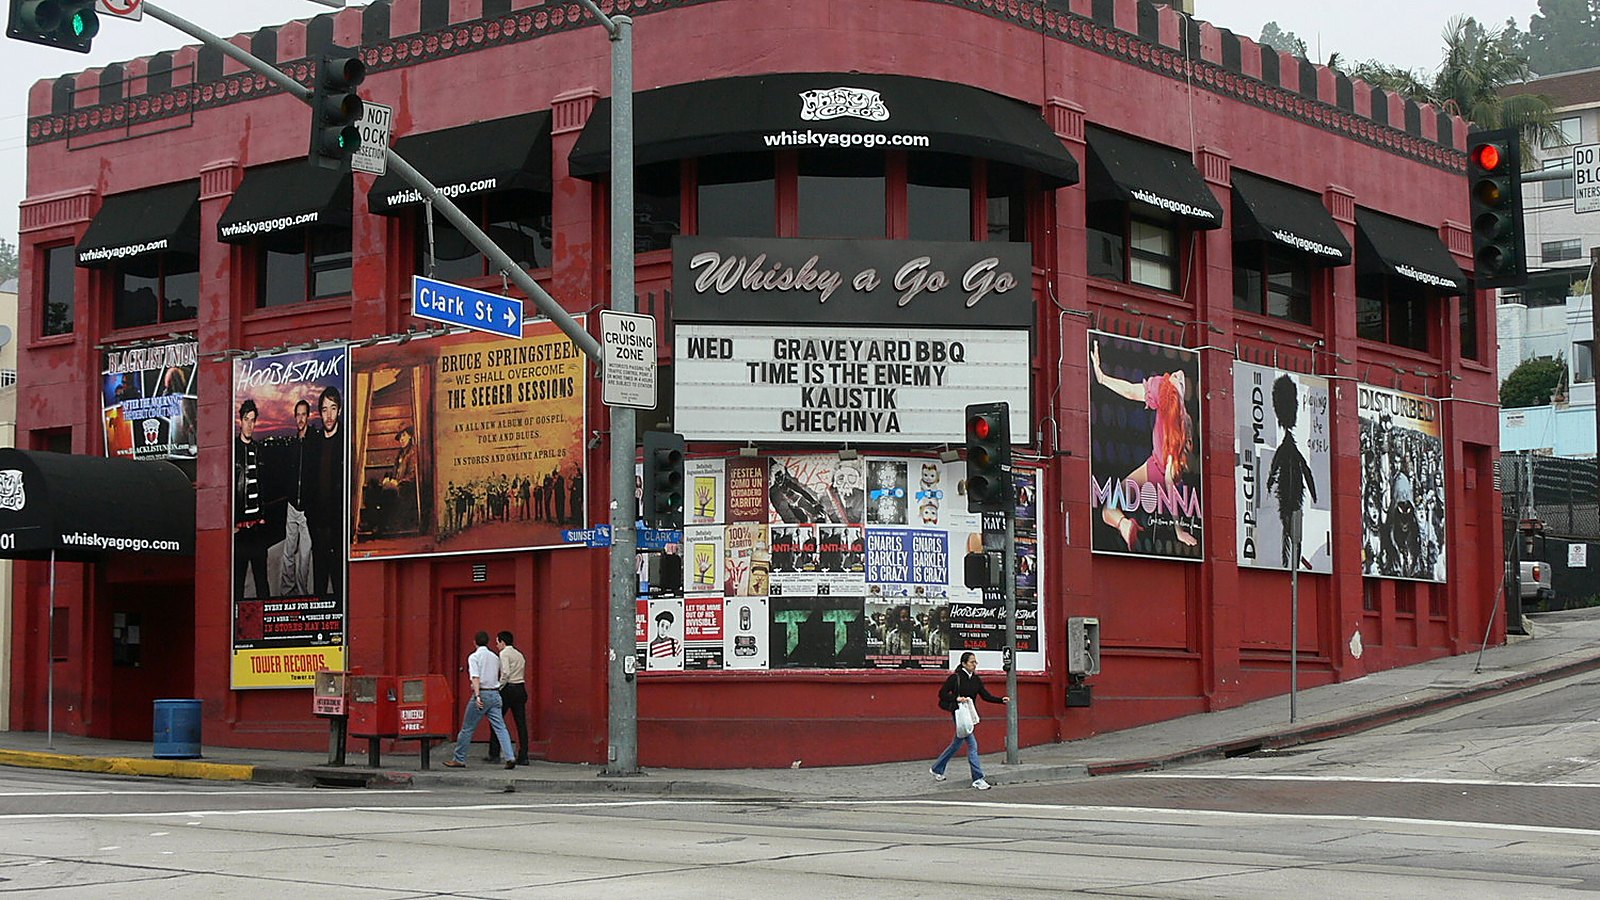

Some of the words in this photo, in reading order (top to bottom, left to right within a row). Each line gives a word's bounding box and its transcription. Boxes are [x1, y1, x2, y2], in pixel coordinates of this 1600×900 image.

[368, 108, 388, 126] NOT
[363, 127, 386, 146] OCK
[764, 130, 930, 148] whiskyagogo.com
[361, 145, 385, 160] SECTION
[1577, 149, 1594, 165] DO
[1577, 166, 1600, 184] BLO
[1576, 186, 1600, 198] INTERS
[1131, 190, 1214, 219] whiskyagogo.com
[221, 210, 318, 237] whiskyagogo.com
[80, 238, 167, 263] whiskyagogo.com
[1273, 230, 1343, 258] whiskyagogo.com
[690, 251, 844, 302] Whisky
[852, 268, 881, 292] a
[894, 256, 950, 307] Go
[963, 257, 1018, 308] Go
[1395, 264, 1457, 288] whiskyagogo.com
[420, 288, 464, 316] Clark
[474, 300, 493, 323] St
[620, 320, 636, 332] NO
[606, 332, 652, 348] CRUISING
[687, 337, 733, 360] WED
[108, 346, 165, 376] BLACKLIST
[165, 342, 198, 368] UNION
[442, 352, 482, 373] BRUCE
[487, 341, 580, 368] SPRINGSTEEN
[616, 347, 644, 360] ZONE
[236, 354, 344, 391] HOOBASTANK
[456, 374, 470, 385] WE
[474, 371, 504, 384] SHALL
[508, 364, 565, 379] OVERCOME
[746, 362, 798, 385] TIME
[804, 362, 824, 384] IS
[828, 362, 868, 385] THE
[874, 364, 947, 387] ENEMY
[448, 388, 466, 409] THE
[472, 384, 512, 407] SEEGER
[518, 376, 574, 402] SESSIONS
[801, 387, 897, 409] KAUSTIK
[1358, 387, 1434, 422] DISTURBED
[454, 424, 464, 432] AN
[465, 421, 480, 431] ALL
[480, 420, 496, 430] NEW
[498, 418, 522, 429] ALBUM
[524, 417, 533, 426] OF
[781, 410, 901, 433] CHECHNYA
[478, 434, 497, 444] FOLK
[498, 433, 514, 442] AND
[454, 457, 461, 466] IN
[463, 455, 490, 465] STORES
[491, 453, 505, 462] AND
[506, 451, 532, 461] ONLINE
[533, 449, 556, 459] APRIL
[558, 449, 566, 457] 25
[730, 479, 750, 489] COMO
[751, 478, 763, 488] UN
[730, 498, 762, 508] CABRITO!
[1092, 475, 1202, 519] MADONNA
[984, 517, 1000, 530] MAY
[0, 533, 15, 550] 01
[62, 532, 180, 551] whiskyagogo.com
[568, 530, 596, 541] SUNSET
[644, 531, 671, 542] CLARK
[728, 528, 752, 540] 100%
[729, 539, 752, 548] CABRITO
[868, 535, 902, 551] GNARLS
[912, 536, 942, 553] GNARLS
[868, 551, 908, 566] BARKLEY
[913, 552, 946, 568] BARKLEY
[868, 566, 878, 581] IS
[880, 566, 909, 581] CRAZY
[913, 567, 923, 582] IS
[924, 567, 947, 583] CRAZY
[264, 603, 283, 612] EVERY
[297, 602, 309, 610] FOR
[310, 601, 336, 609] HIMSELF
[950, 604, 997, 618] HOOBASTANK
[265, 624, 273, 632] IN
[275, 623, 303, 632] STORES
[304, 622, 319, 630] MAY
[322, 621, 340, 630] 16TH
[686, 618, 716, 626] INVISIBLE
[251, 655, 281, 674] TOWER
[284, 654, 325, 672] RECORDS
